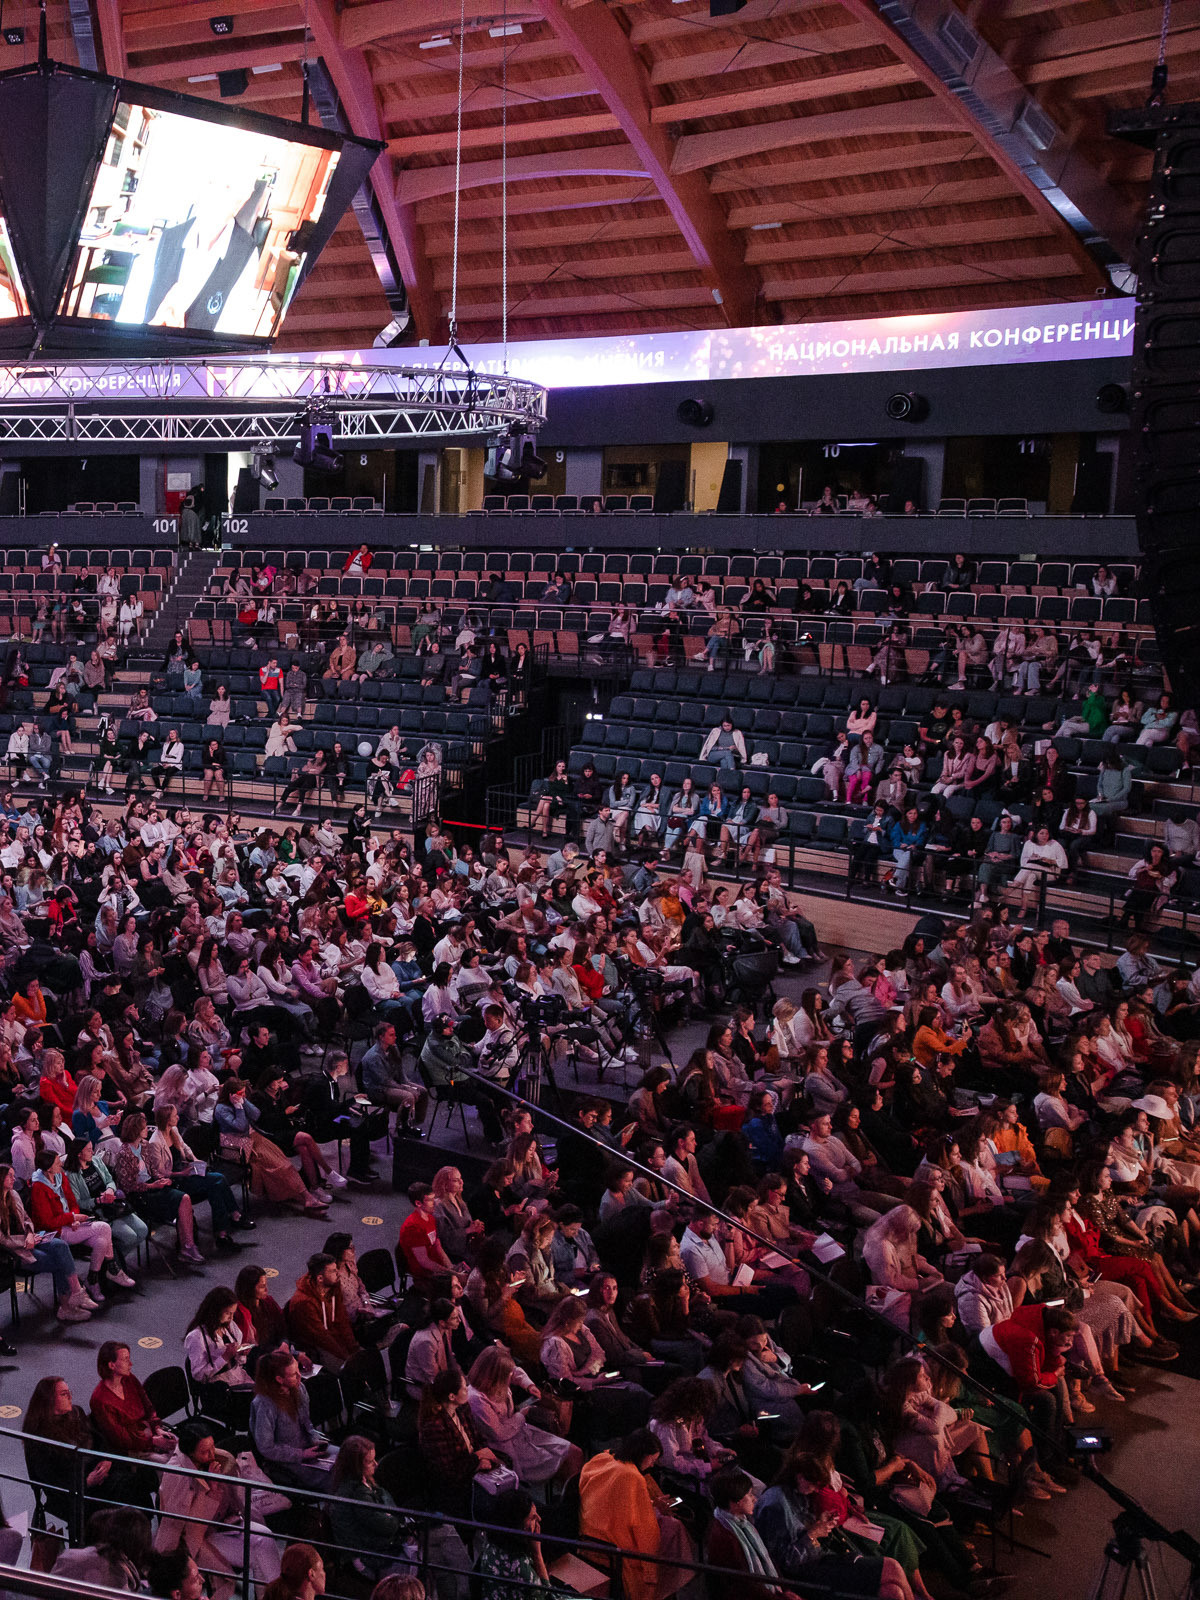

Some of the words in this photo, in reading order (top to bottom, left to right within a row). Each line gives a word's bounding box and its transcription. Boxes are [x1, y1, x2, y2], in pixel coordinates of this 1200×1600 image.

[770, 331, 960, 361] НАЦИОНАЛЬНАЯ
[822, 444, 840, 458] 10
[1018, 439, 1035, 454] 11
[359, 454, 368, 466] 8
[555, 450, 564, 463] 9
[80, 459, 88, 471] 7
[152, 519, 177, 533] 101
[223, 519, 248, 533] 102
